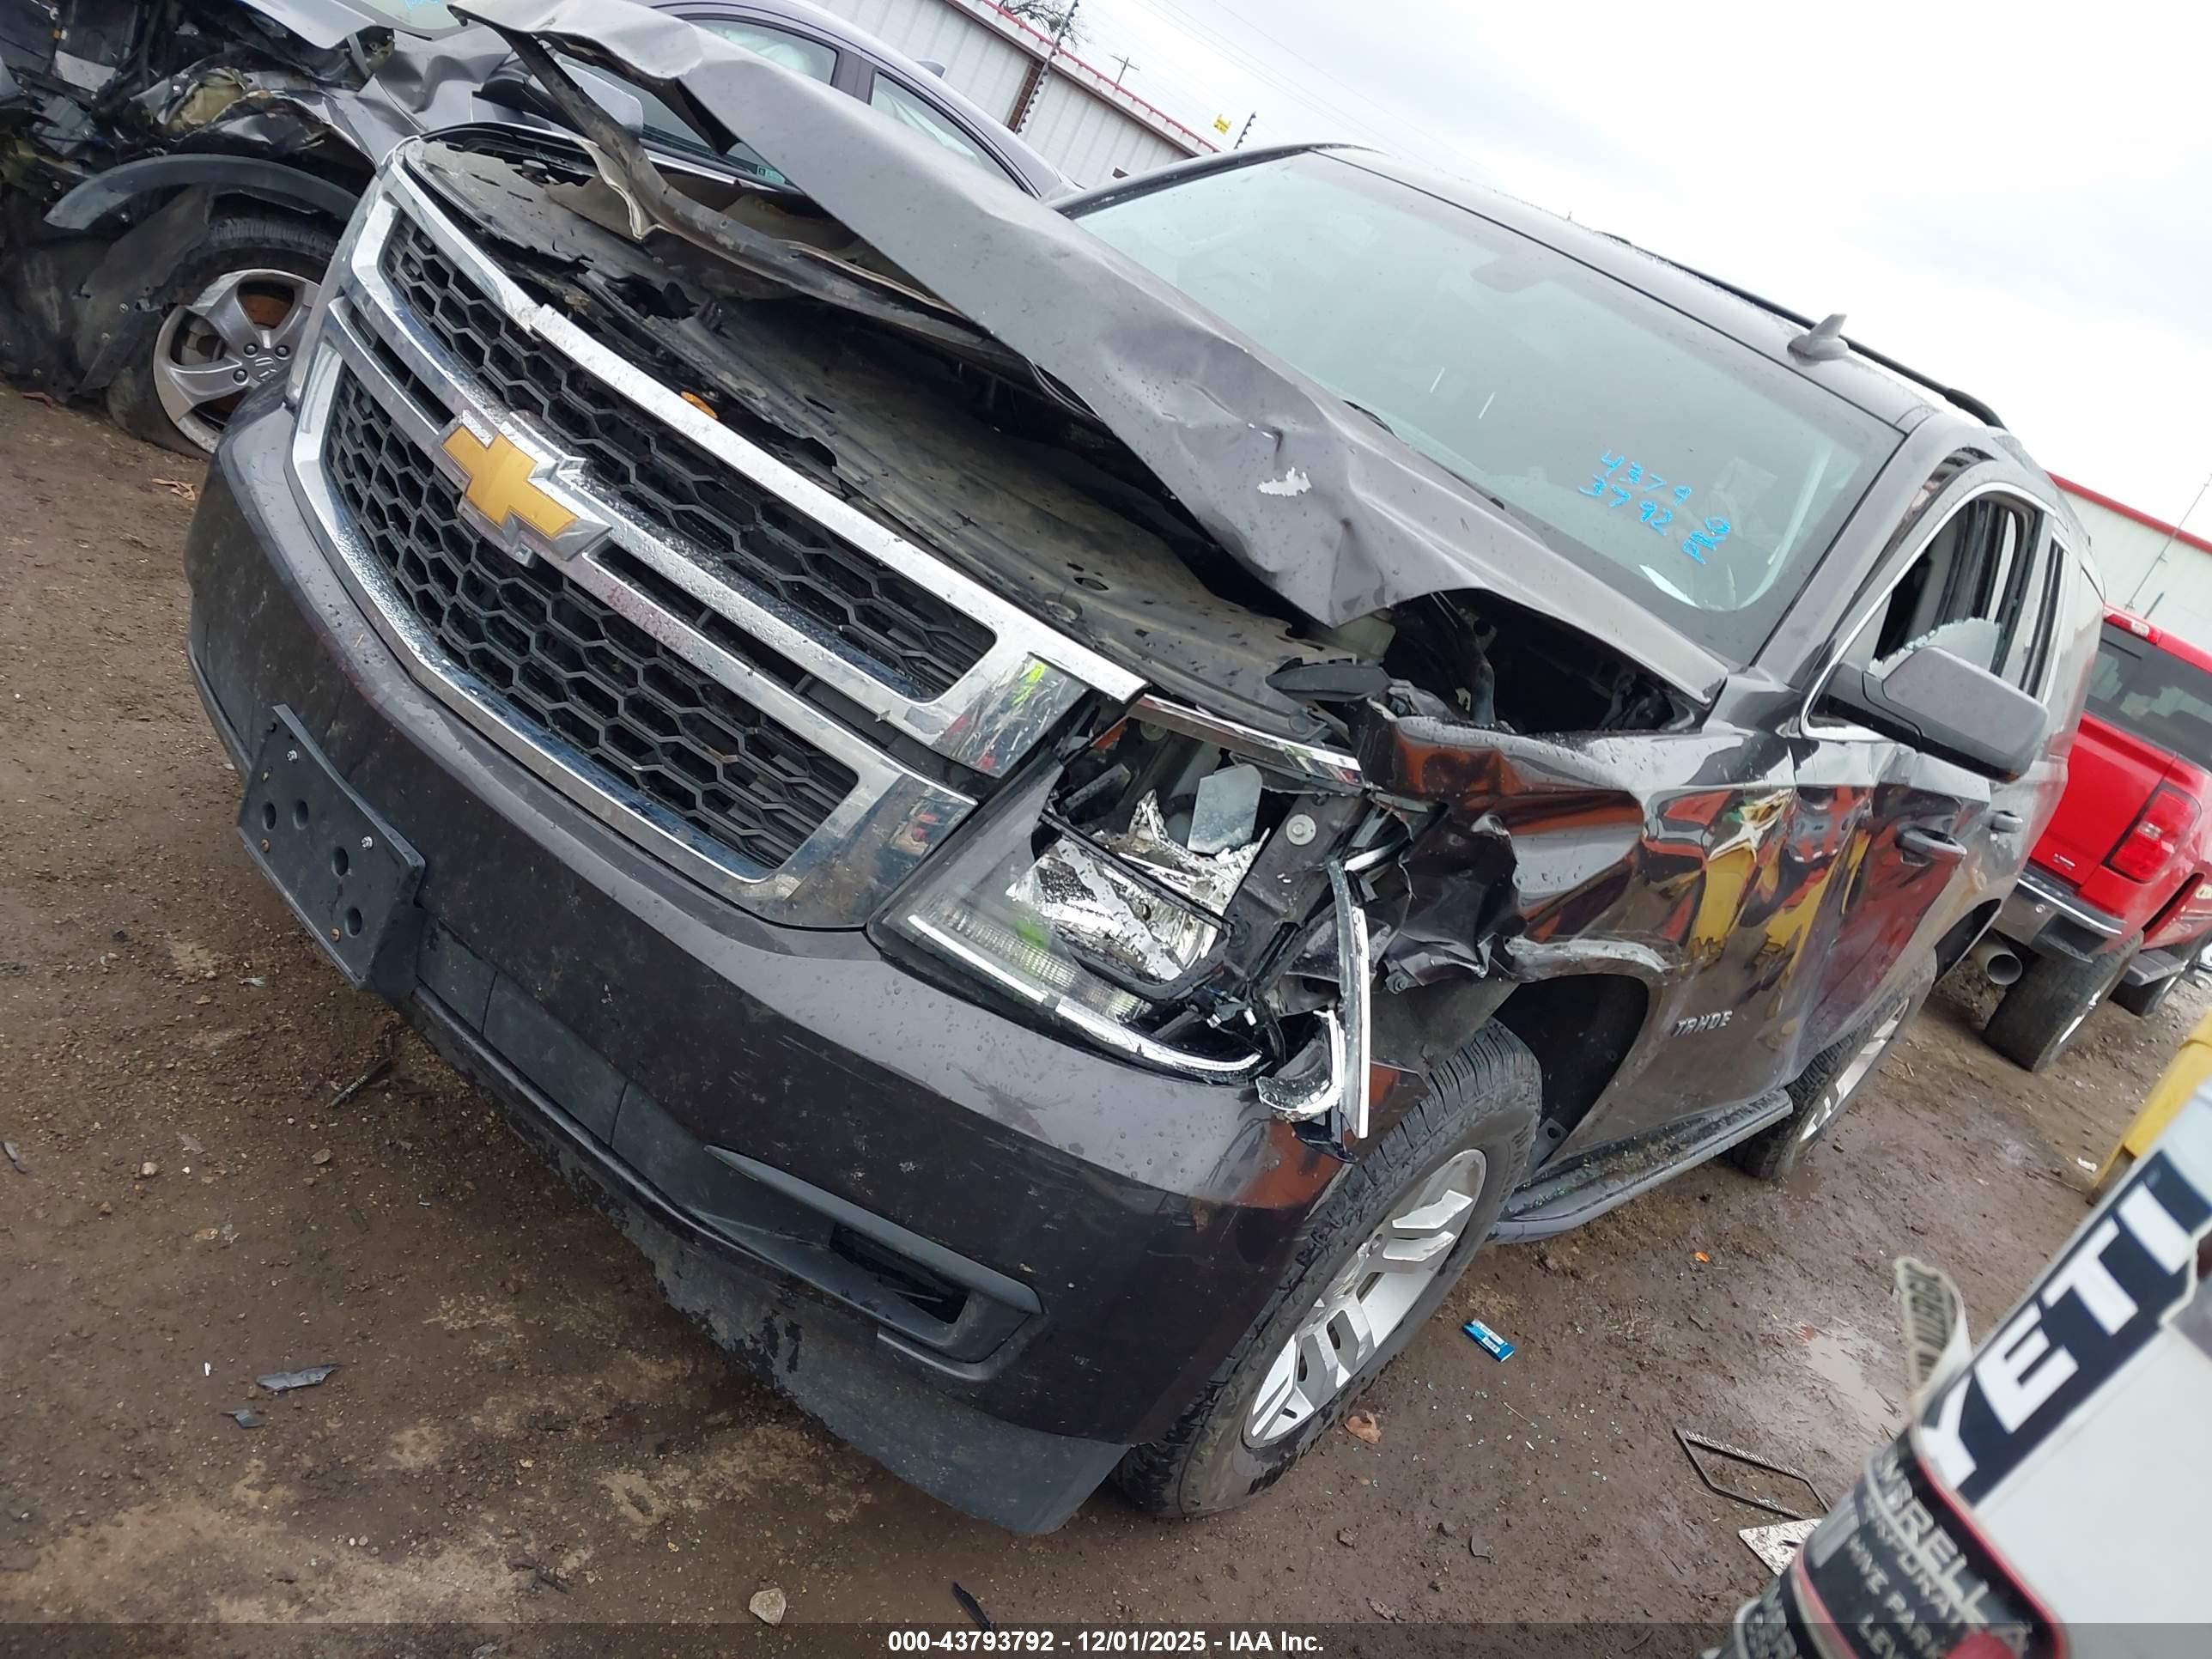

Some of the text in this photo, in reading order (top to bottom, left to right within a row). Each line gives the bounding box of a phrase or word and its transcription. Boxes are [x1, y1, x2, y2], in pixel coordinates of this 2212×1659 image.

[1578, 473, 1672, 537] 3792
[1601, 449, 1692, 507] 4379
[1671, 1010, 1733, 1037] TAHOE
[1917, 1180, 2193, 1491] YETI
